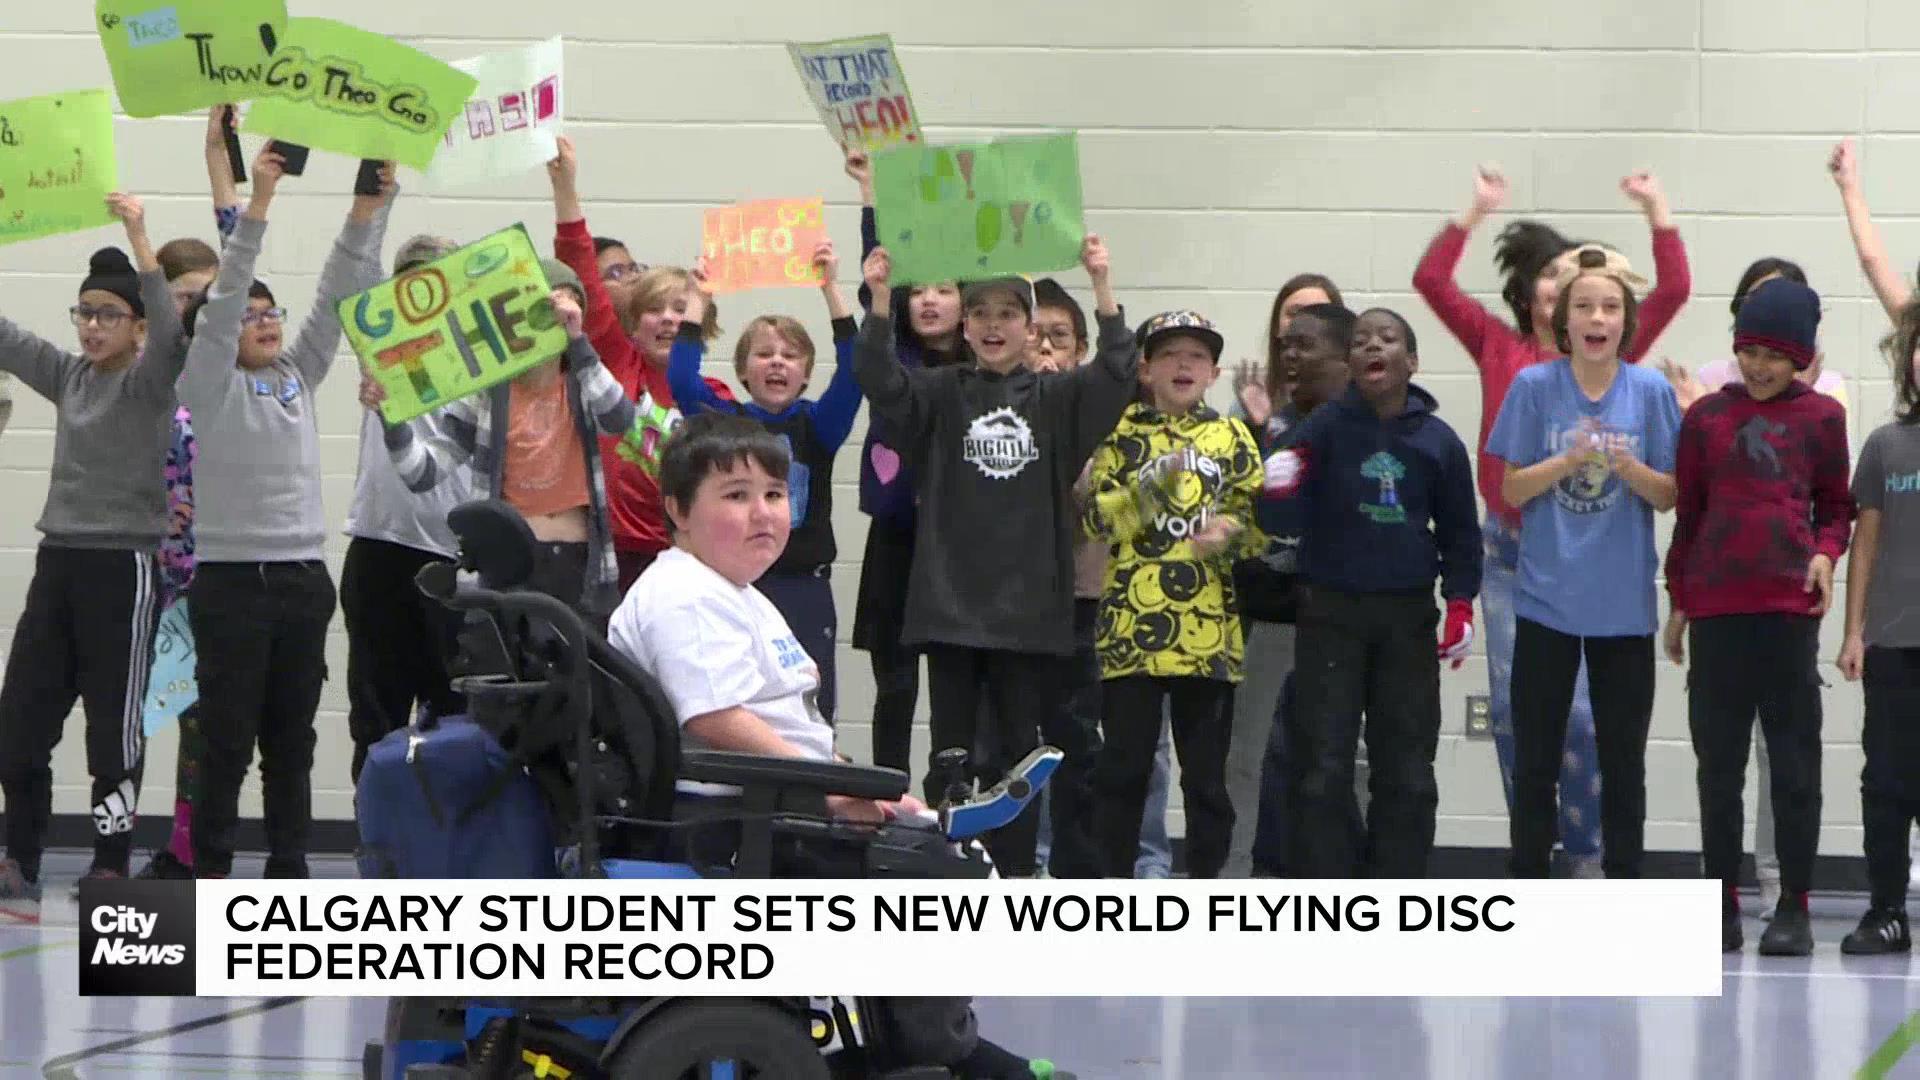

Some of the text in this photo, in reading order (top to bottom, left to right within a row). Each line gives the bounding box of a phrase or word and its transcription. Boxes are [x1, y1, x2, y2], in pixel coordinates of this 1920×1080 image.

[265, 57, 308, 90] Go
[324, 65, 377, 105] Theo
[824, 95, 917, 141] HEO!
[354, 267, 449, 339] GO
